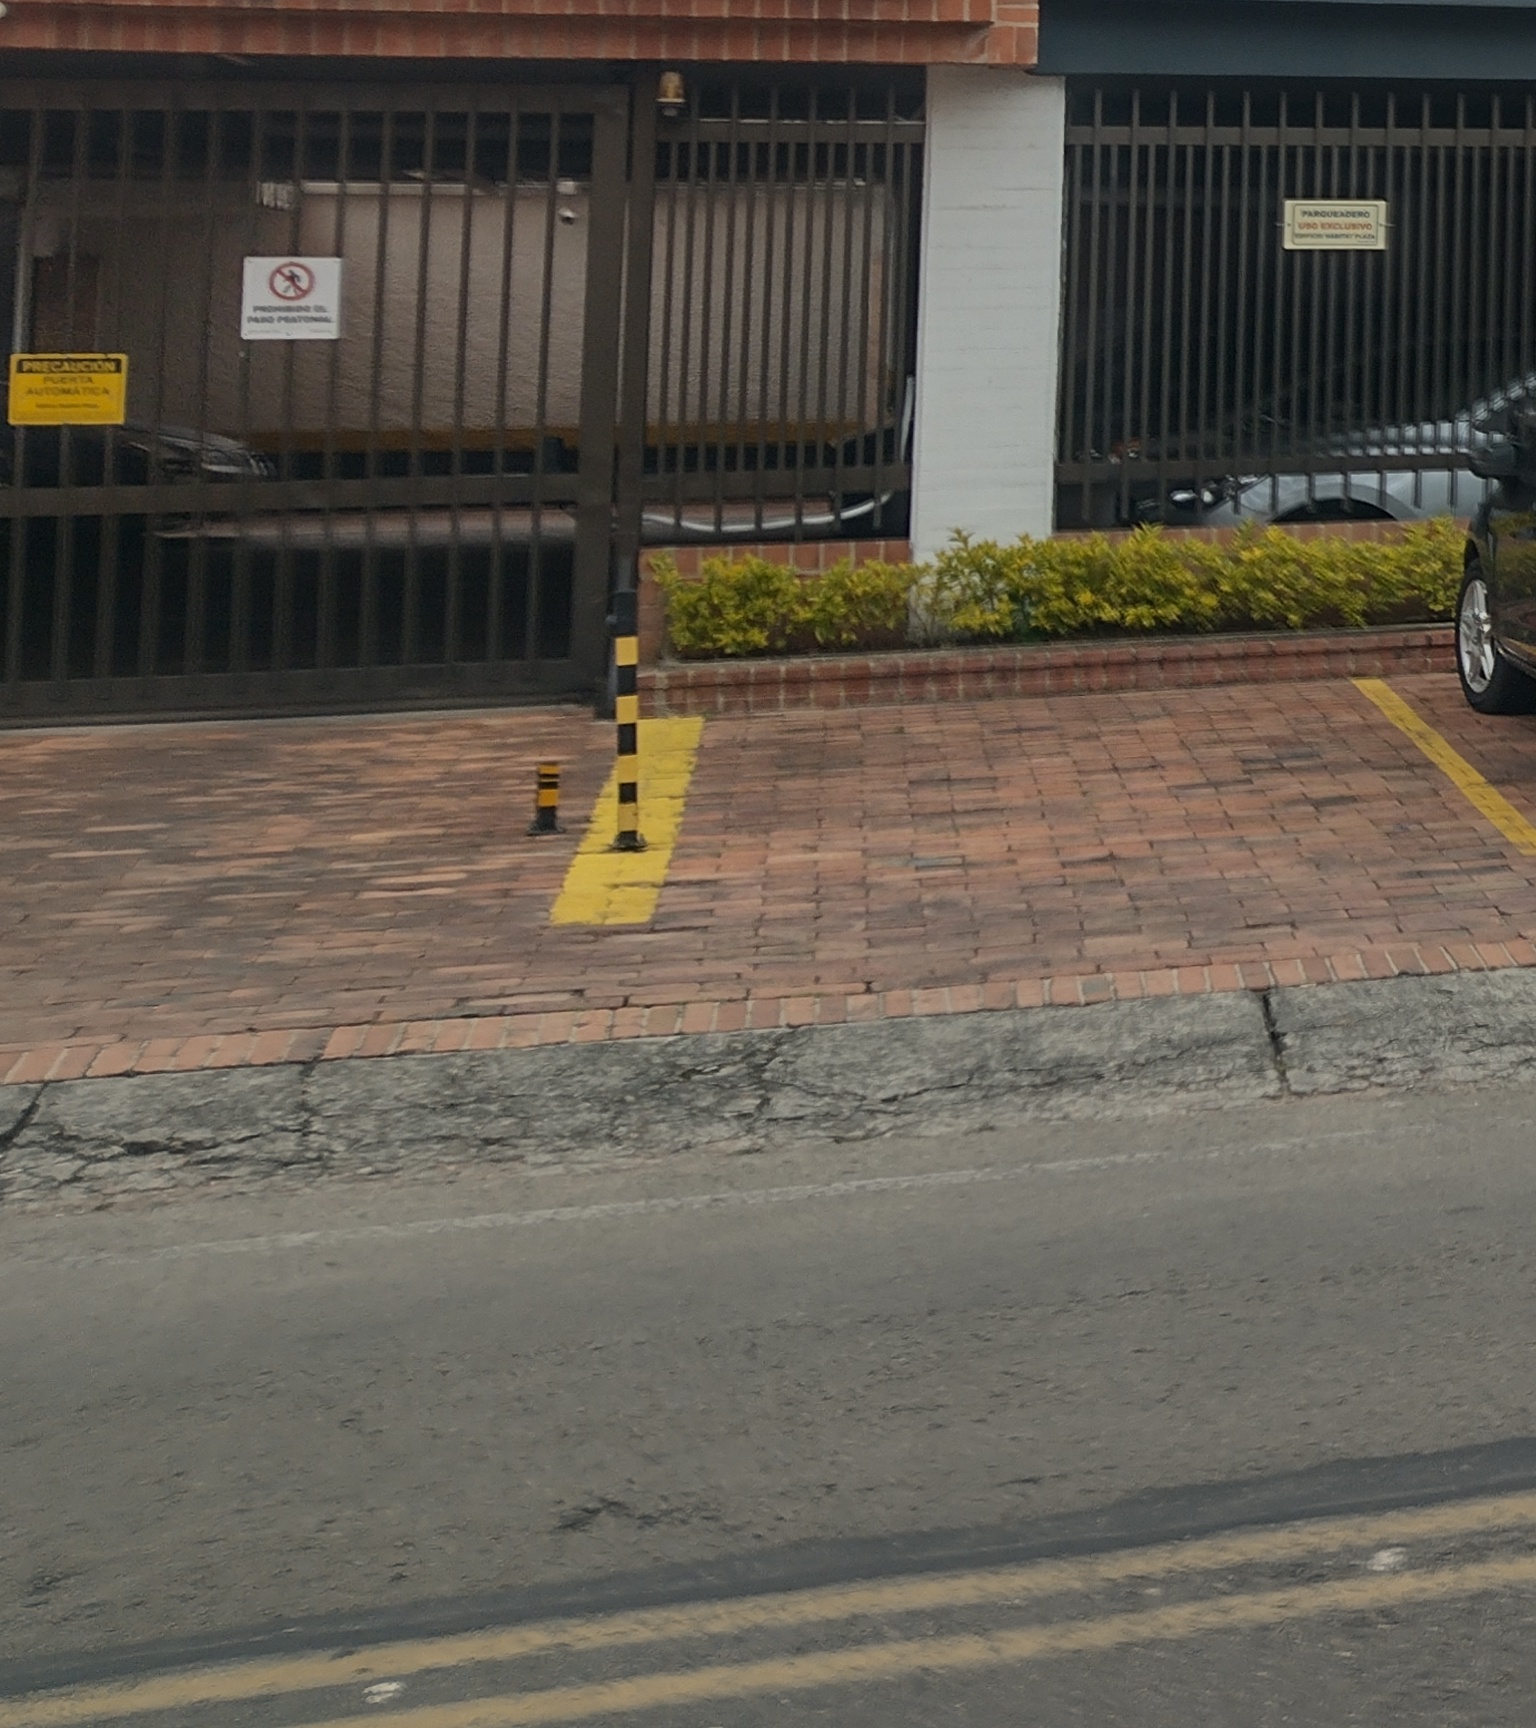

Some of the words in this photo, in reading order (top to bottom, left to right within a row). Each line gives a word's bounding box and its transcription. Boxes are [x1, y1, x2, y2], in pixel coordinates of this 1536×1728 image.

[1302, 210, 1371, 219] PARQUEADERO
[1298, 222, 1318, 231] USO
[1320, 222, 1373, 231] EXCLUSIVO
